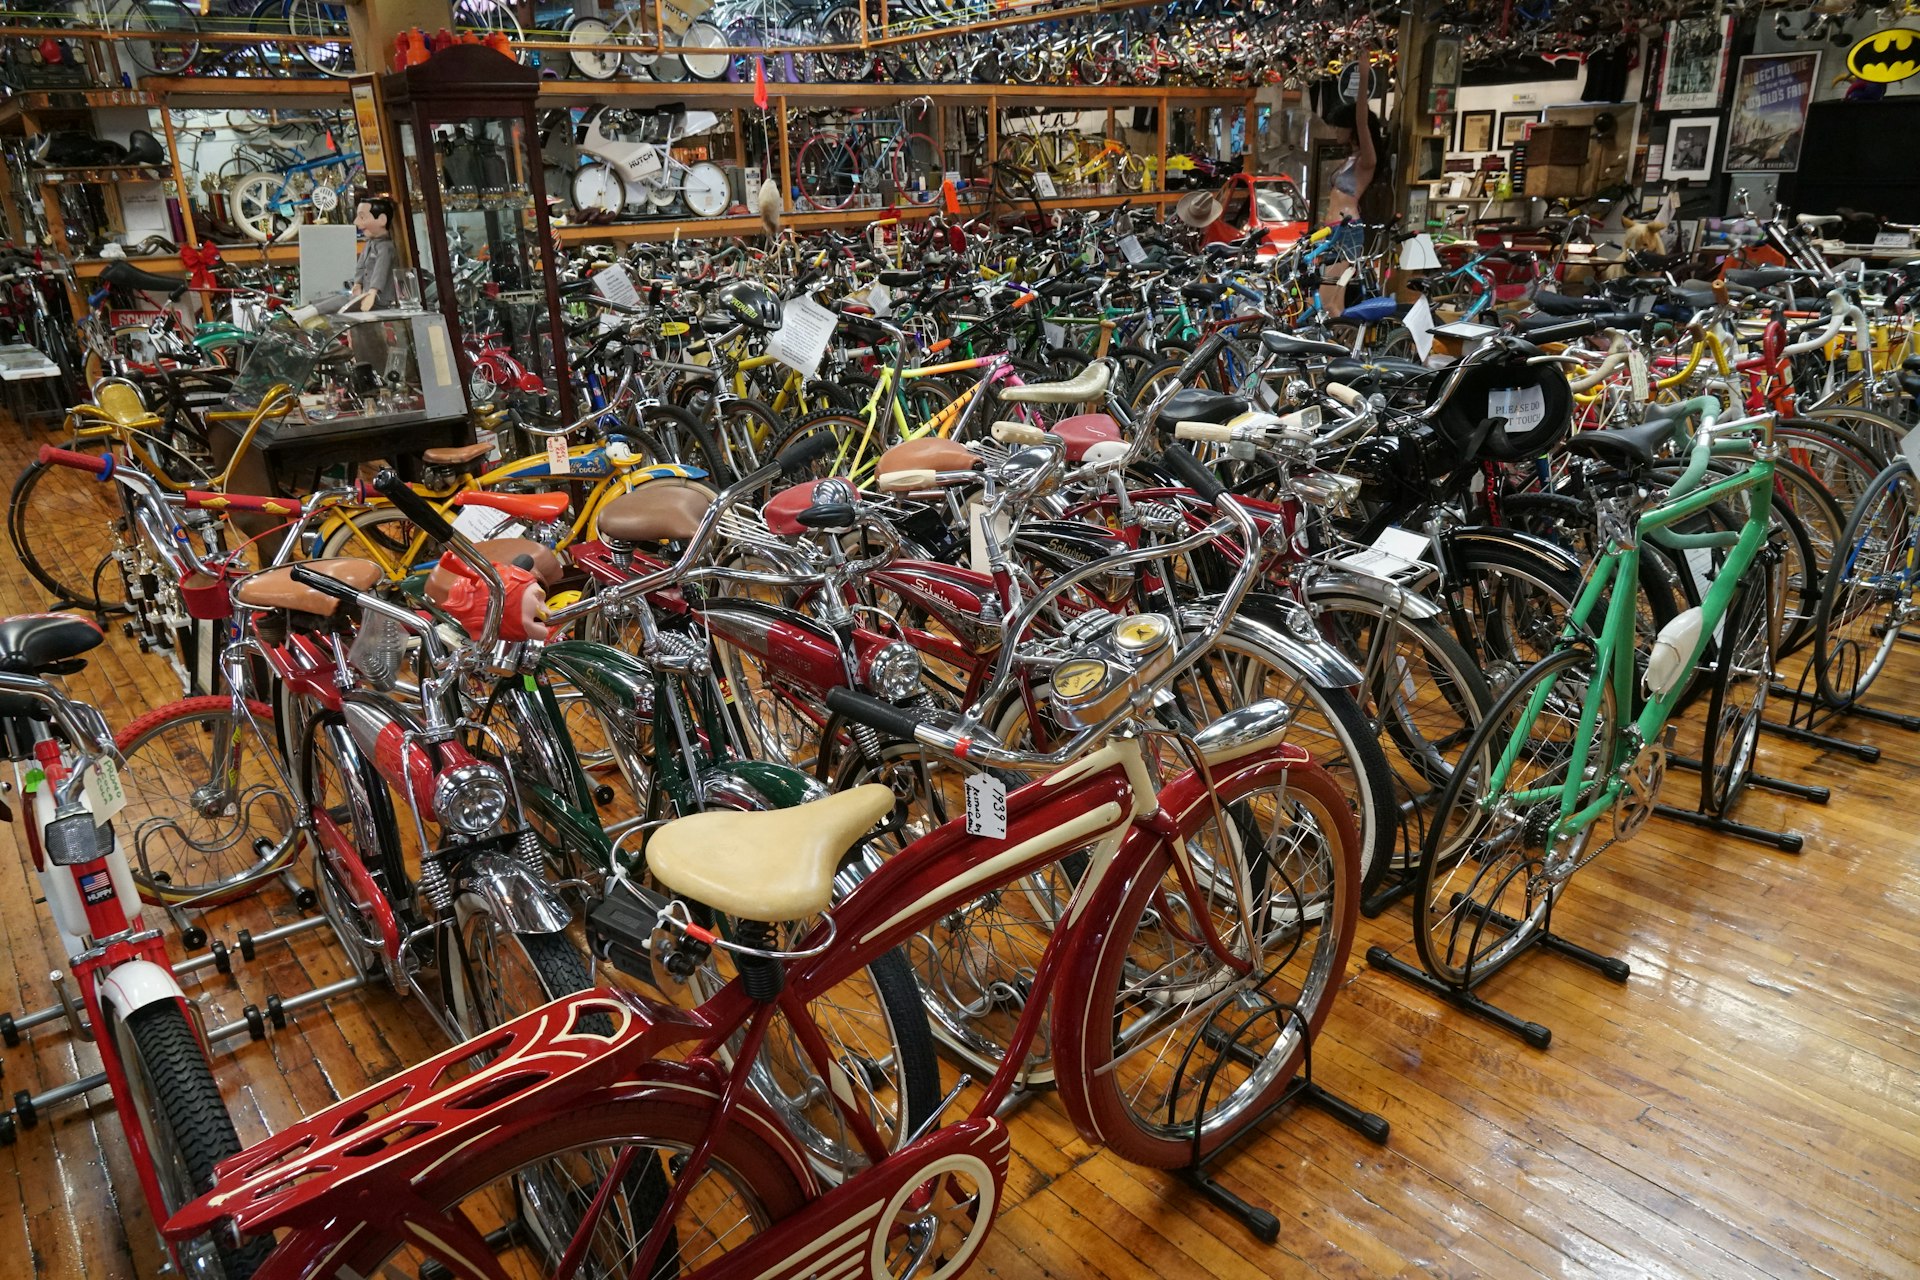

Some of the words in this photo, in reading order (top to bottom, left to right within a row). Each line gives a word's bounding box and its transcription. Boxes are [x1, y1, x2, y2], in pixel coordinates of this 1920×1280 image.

[664, 2, 689, 21] HUTCH
[1745, 87, 1785, 110] WORLD'S
[1787, 82, 1809, 99] FAIR
[628, 152, 654, 169] HUTCH
[731, 297, 758, 319] SPECIALIZED
[1495, 403, 1529, 415] PLEASE
[1530, 401, 1540, 411] DO
[1516, 413, 1541, 425] TOUCH
[1047, 538, 1091, 562] Schwinn
[911, 578, 958, 609] Schwinn
[1063, 605, 1083, 616] PANT
[992, 788, 1006, 821] 1939
[87, 887, 113, 902] HUFFY
